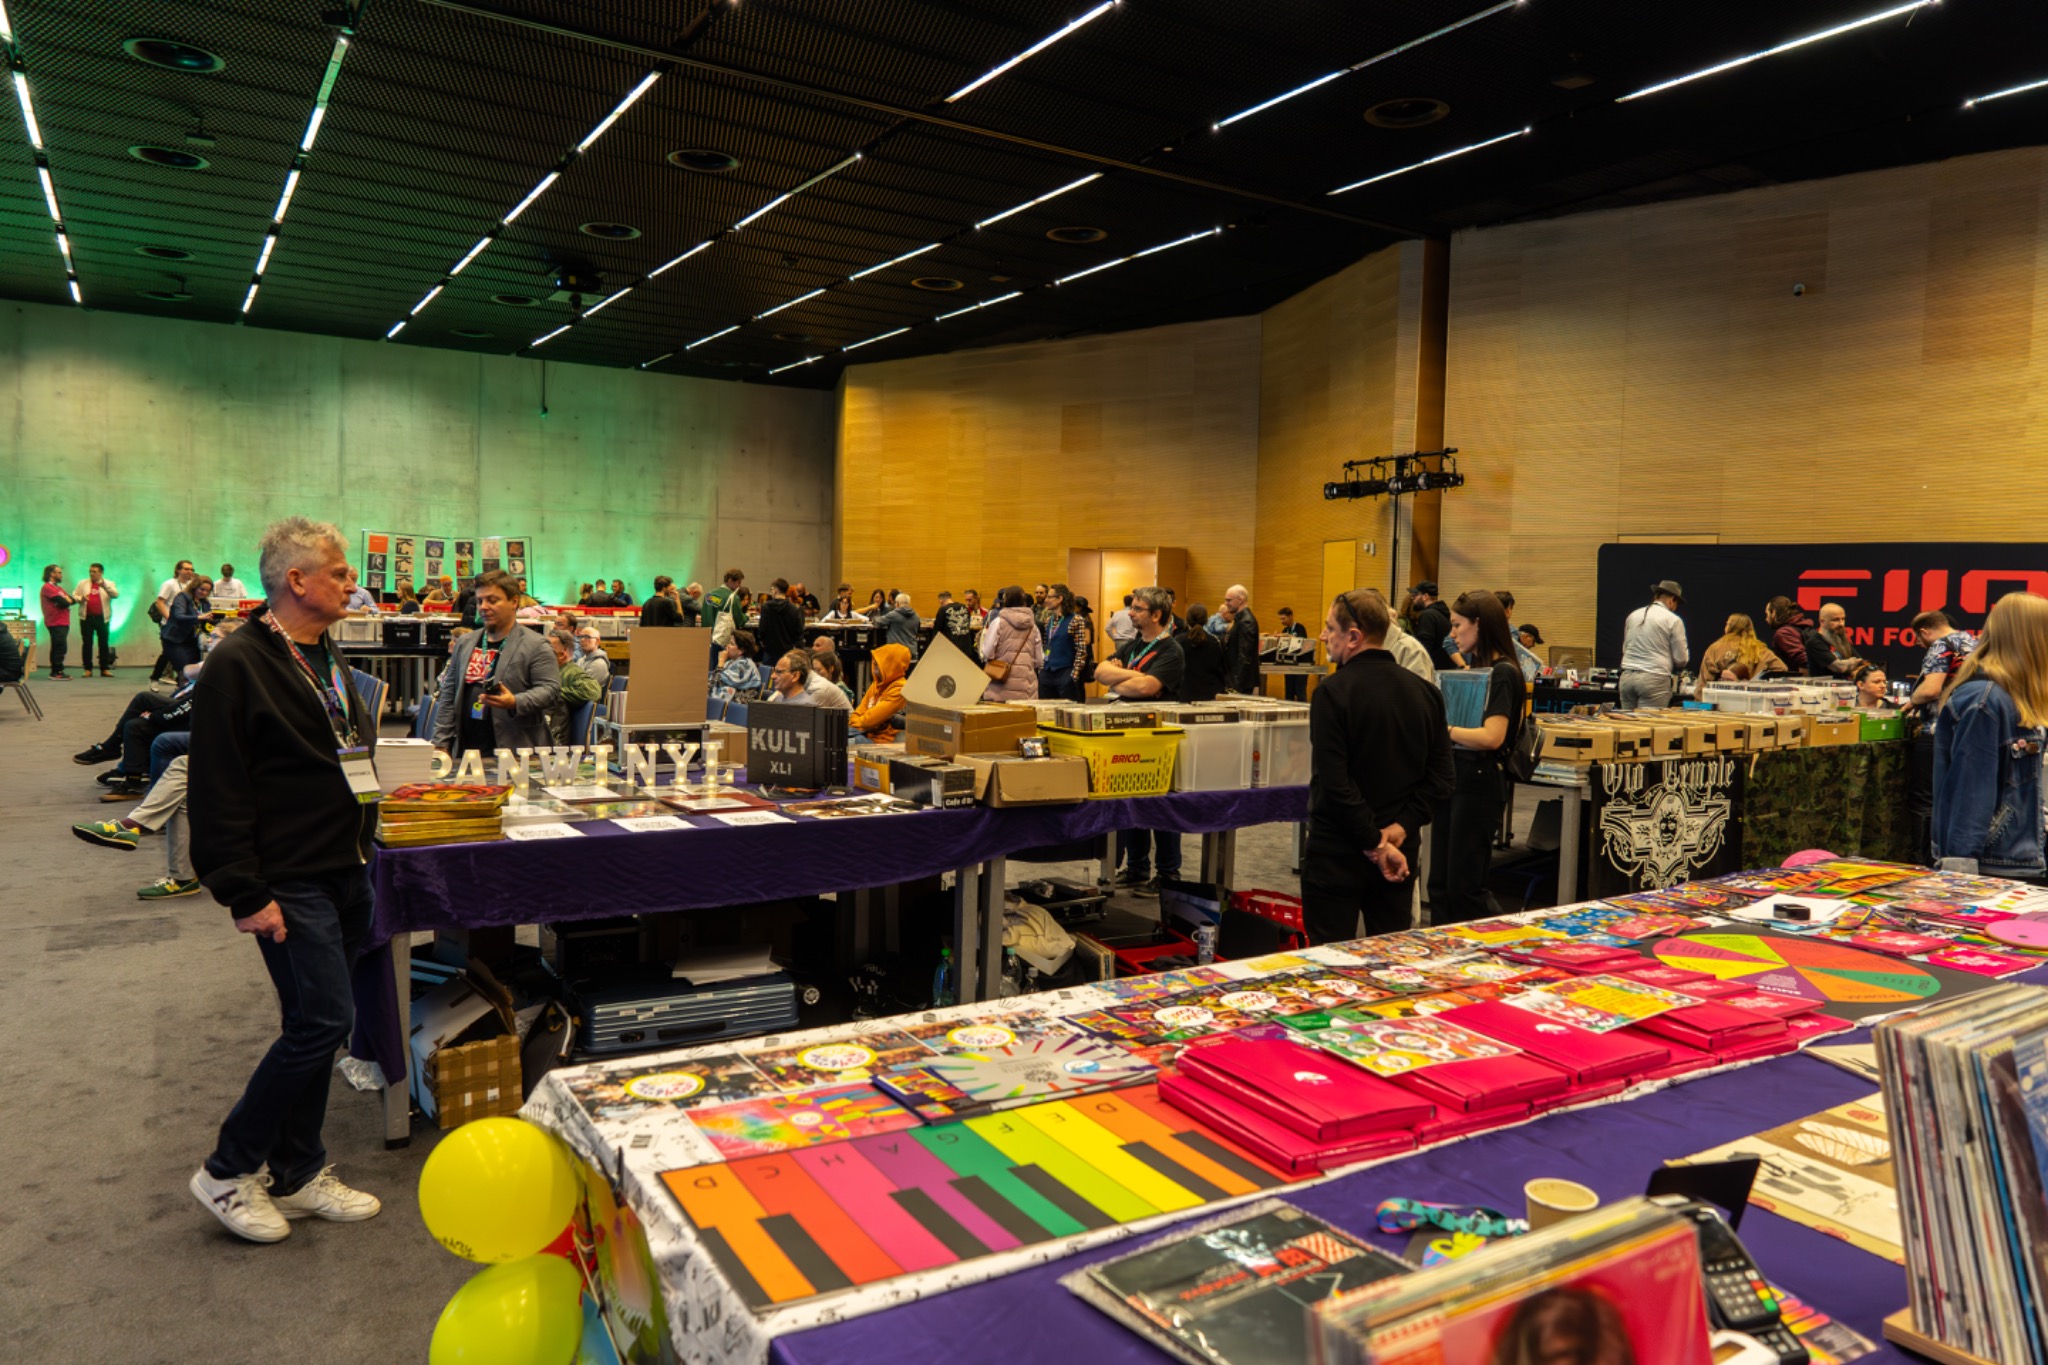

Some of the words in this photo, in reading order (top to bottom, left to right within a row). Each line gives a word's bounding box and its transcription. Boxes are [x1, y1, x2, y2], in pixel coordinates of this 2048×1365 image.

[1883, 627, 1919, 647] FO
[751, 727, 810, 755] KULT
[1111, 753, 1141, 764] BRICO
[820, 1154, 846, 1167] H
